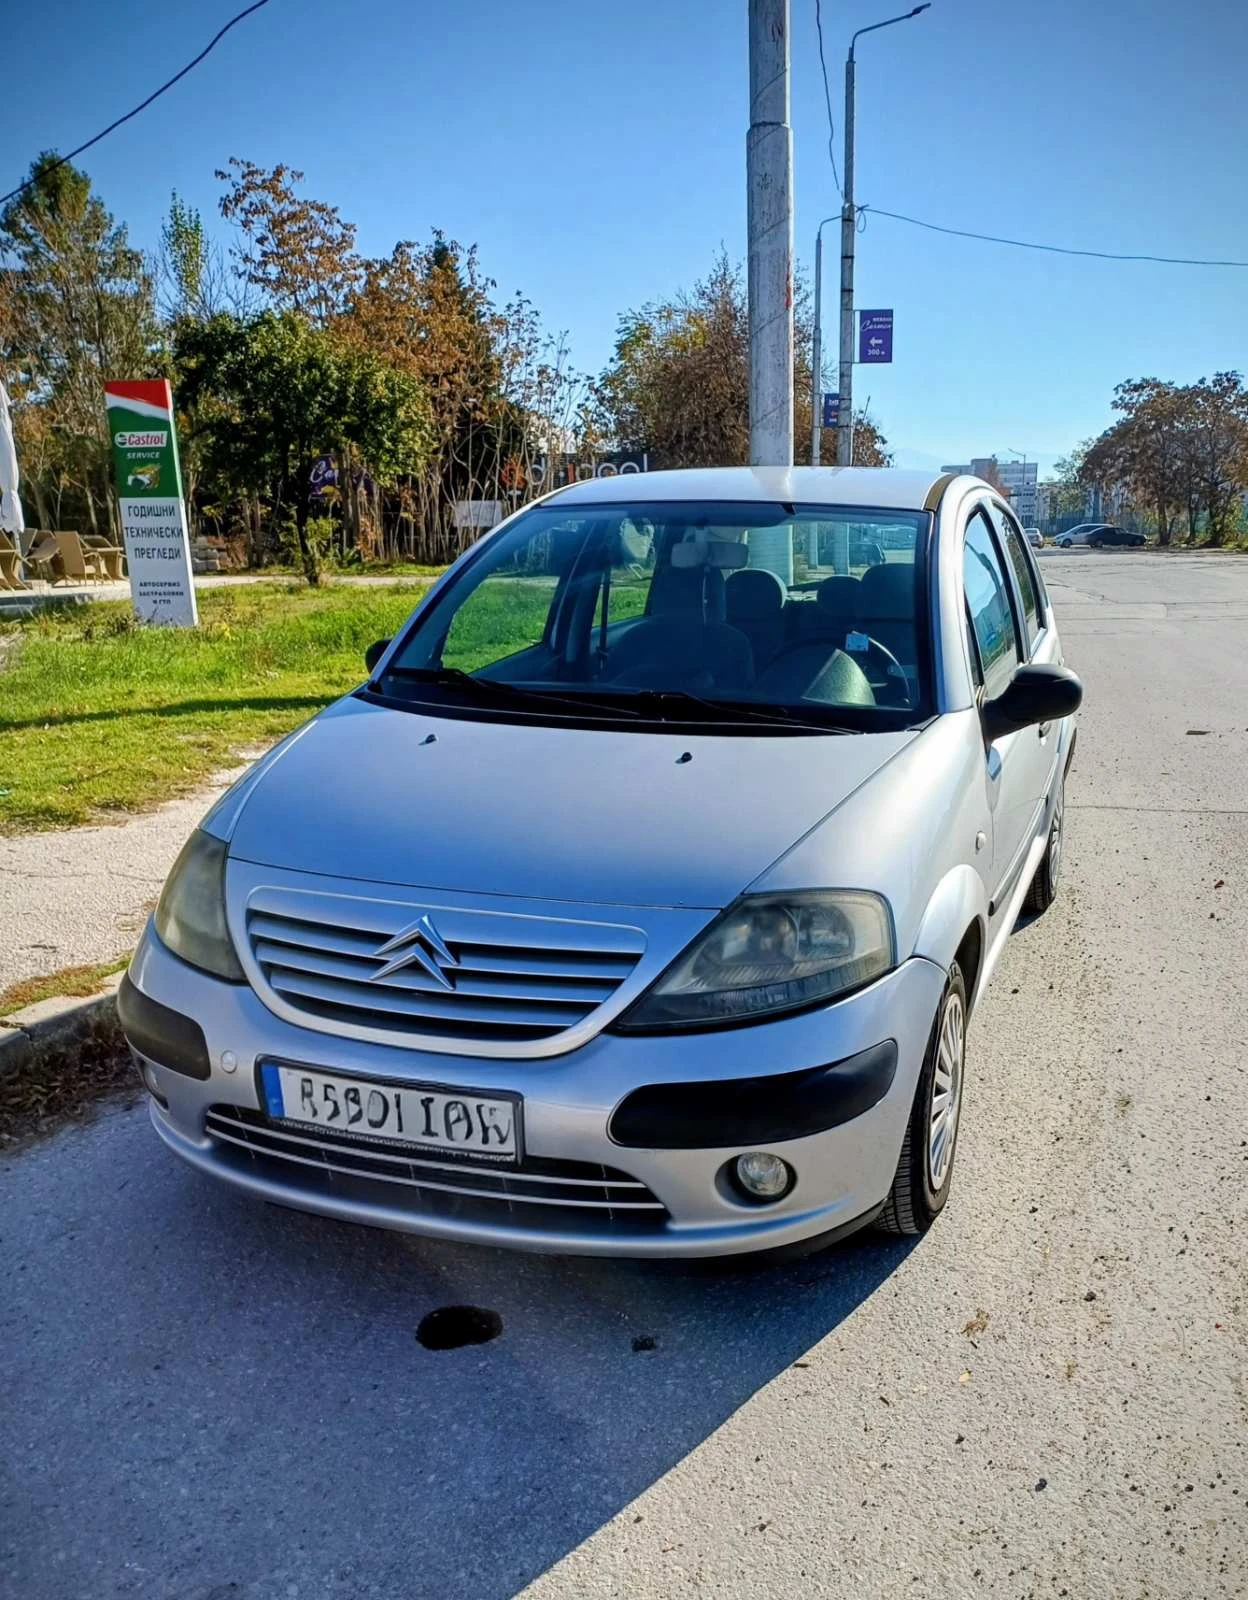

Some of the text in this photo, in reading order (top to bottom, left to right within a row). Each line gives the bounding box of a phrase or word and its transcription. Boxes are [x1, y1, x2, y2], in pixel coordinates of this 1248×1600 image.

[127, 433, 164, 446] Castrol
[127, 451, 160, 460] SERVICE
[127, 505, 176, 518] ГОДИШНИ
[124, 526, 184, 538] ТЕХНИЧЕСКИ
[134, 547, 181, 560] ПРЕГЛЕДИ
